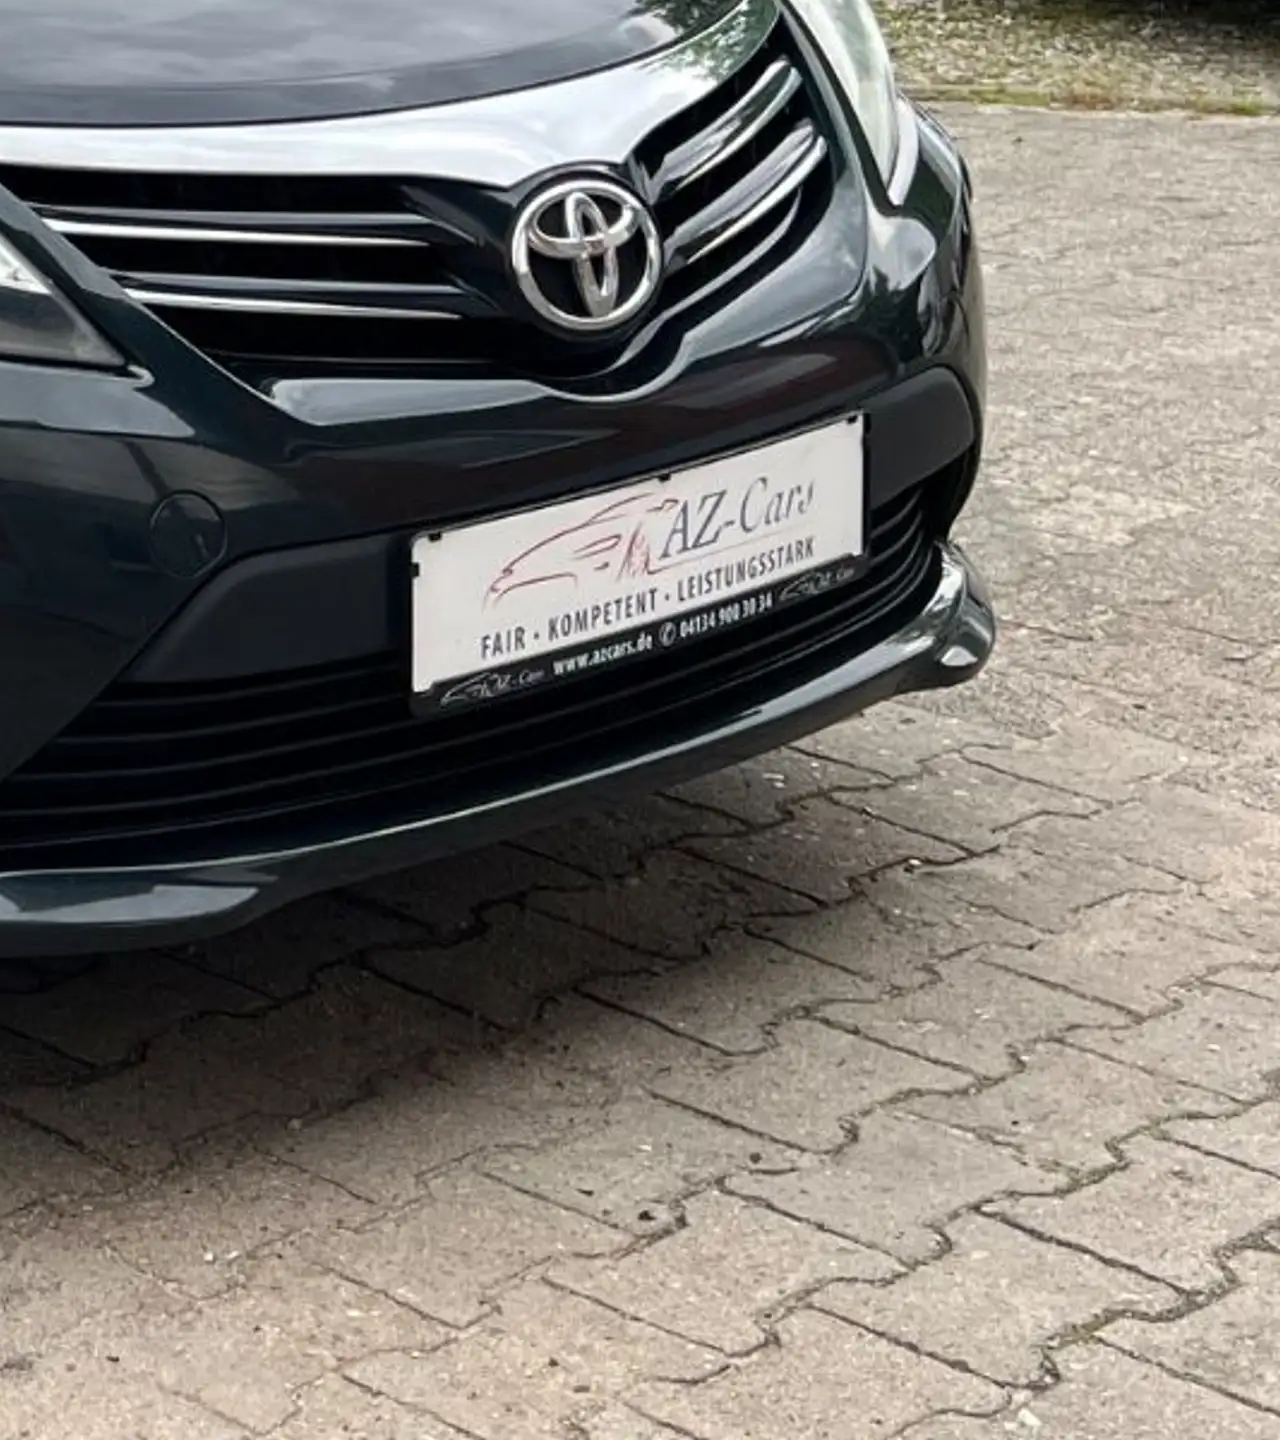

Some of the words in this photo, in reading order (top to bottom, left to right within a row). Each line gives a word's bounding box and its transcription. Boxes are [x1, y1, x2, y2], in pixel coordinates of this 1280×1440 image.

[658, 476, 815, 561] AZ-Cars
[480, 626, 526, 659] FAIR
[548, 588, 658, 642] KOMPETENT
[677, 536, 815, 601] LEISTUNGSSTARK
[553, 632, 653, 675] www.azcars.de
